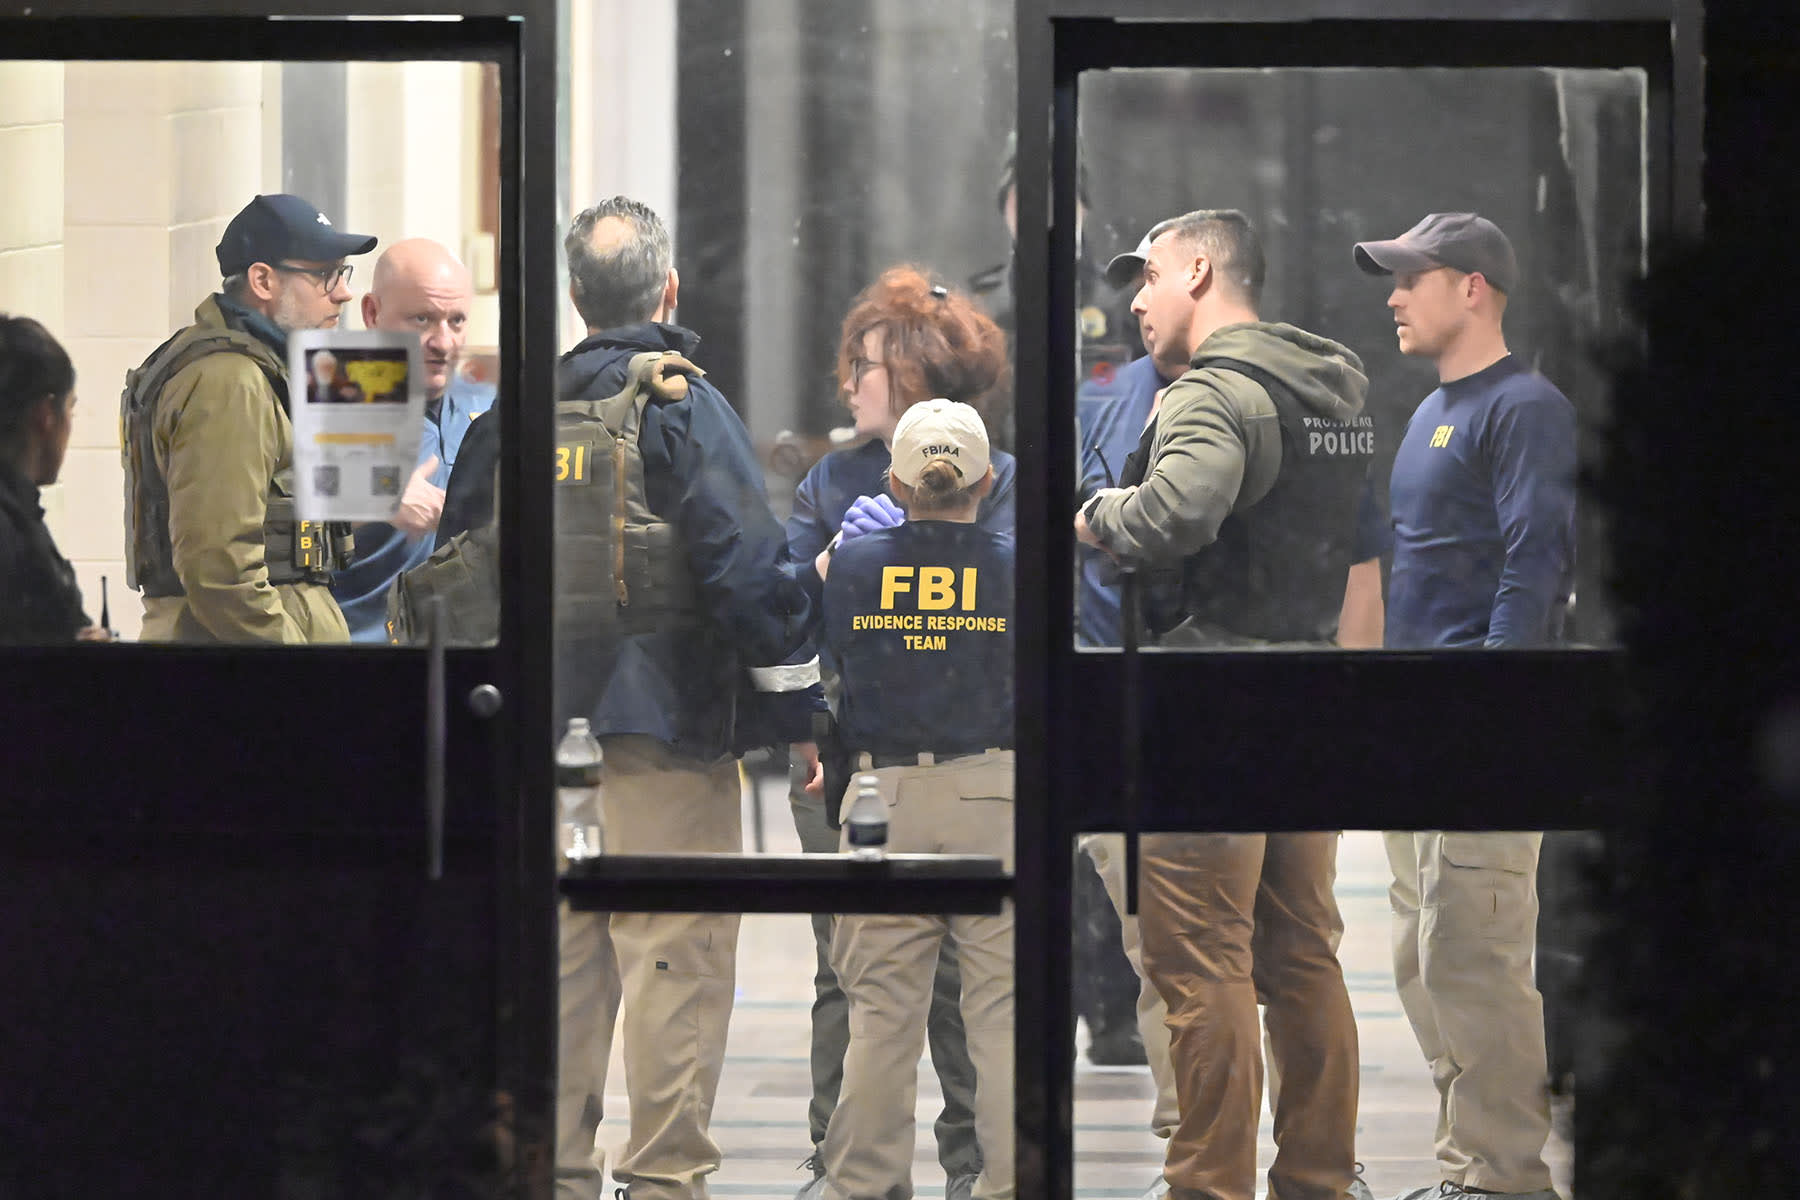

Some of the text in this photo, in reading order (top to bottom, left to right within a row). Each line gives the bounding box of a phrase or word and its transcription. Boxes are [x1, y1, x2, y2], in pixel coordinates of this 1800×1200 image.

[1309, 432, 1374, 455] POLICE
[1429, 425, 1455, 448] FBI
[922, 445, 960, 458] FBIAA
[880, 566, 978, 611] FBI
[853, 615, 1007, 632] EVIDENCE RESPONSE
[904, 635, 947, 650] TEAM
